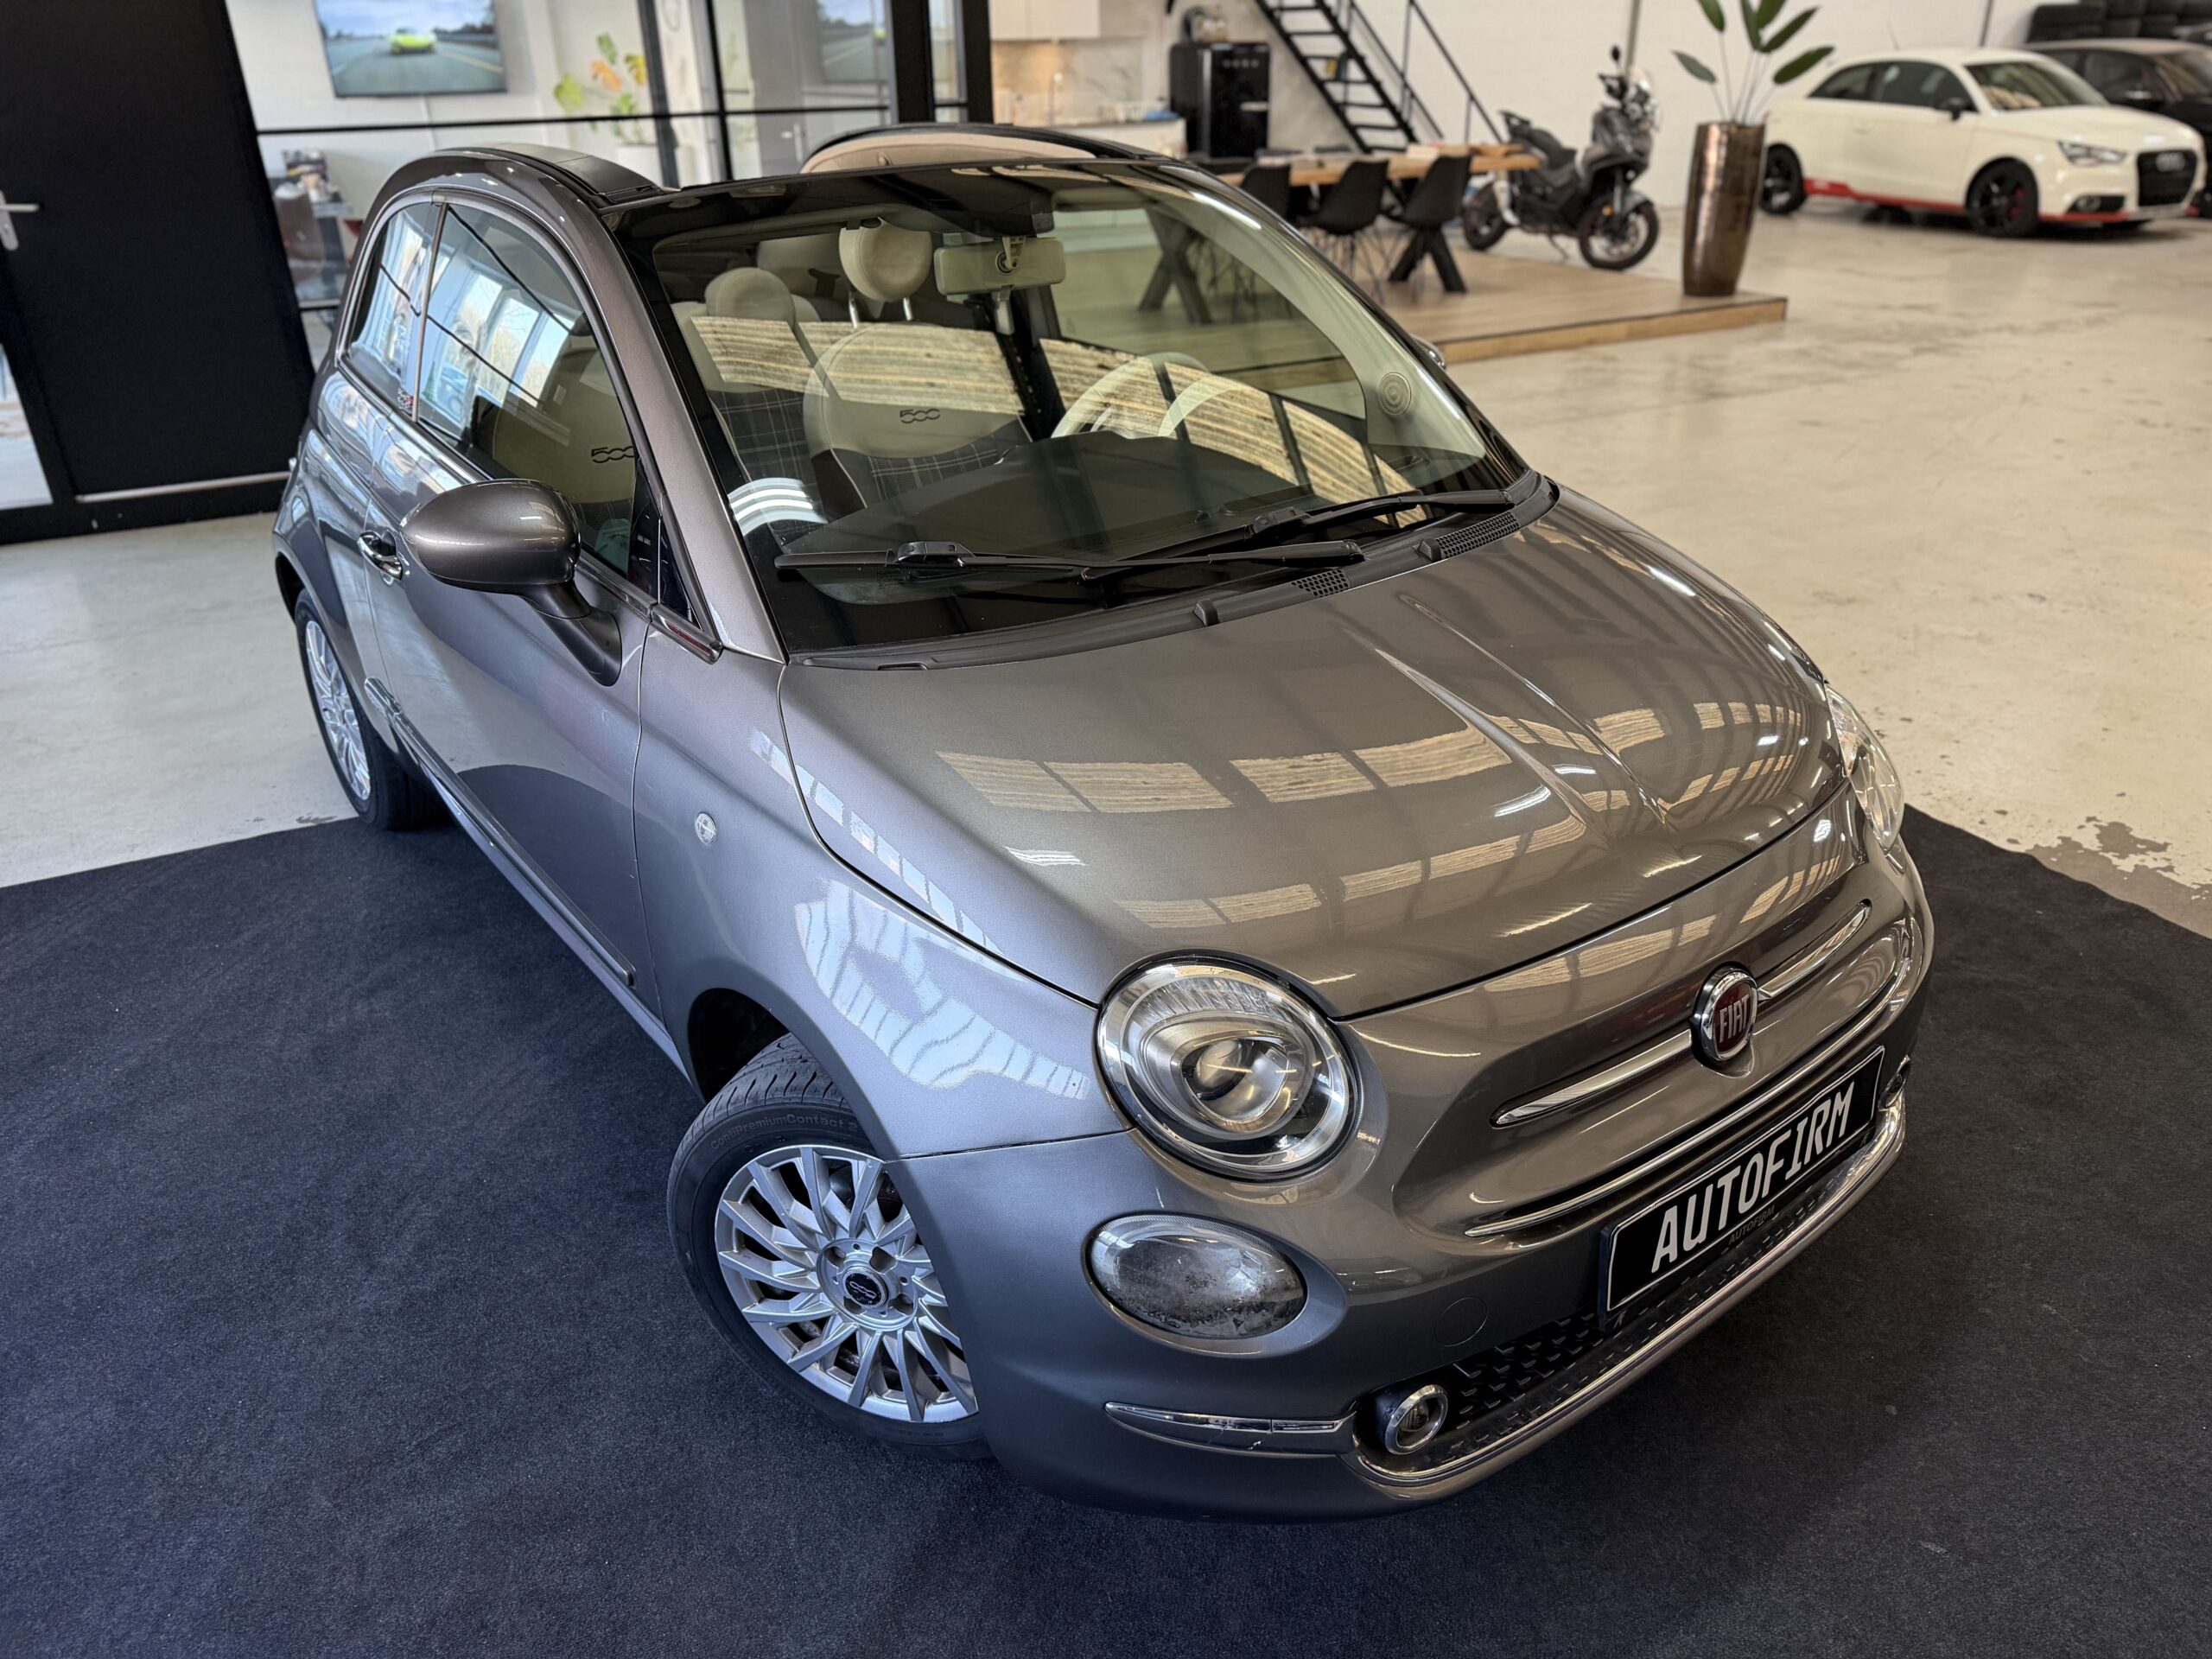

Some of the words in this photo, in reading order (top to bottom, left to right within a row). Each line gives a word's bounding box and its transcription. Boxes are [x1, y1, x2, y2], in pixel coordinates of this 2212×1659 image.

[899, 408, 941, 424] 500
[1719, 994, 1750, 1044] FIAT
[710, 1113, 845, 1150] ContiPremiumContact
[1651, 1081, 1855, 1274] AUTOFIRM
[1728, 1205, 1776, 1246] AUTOFIRM
